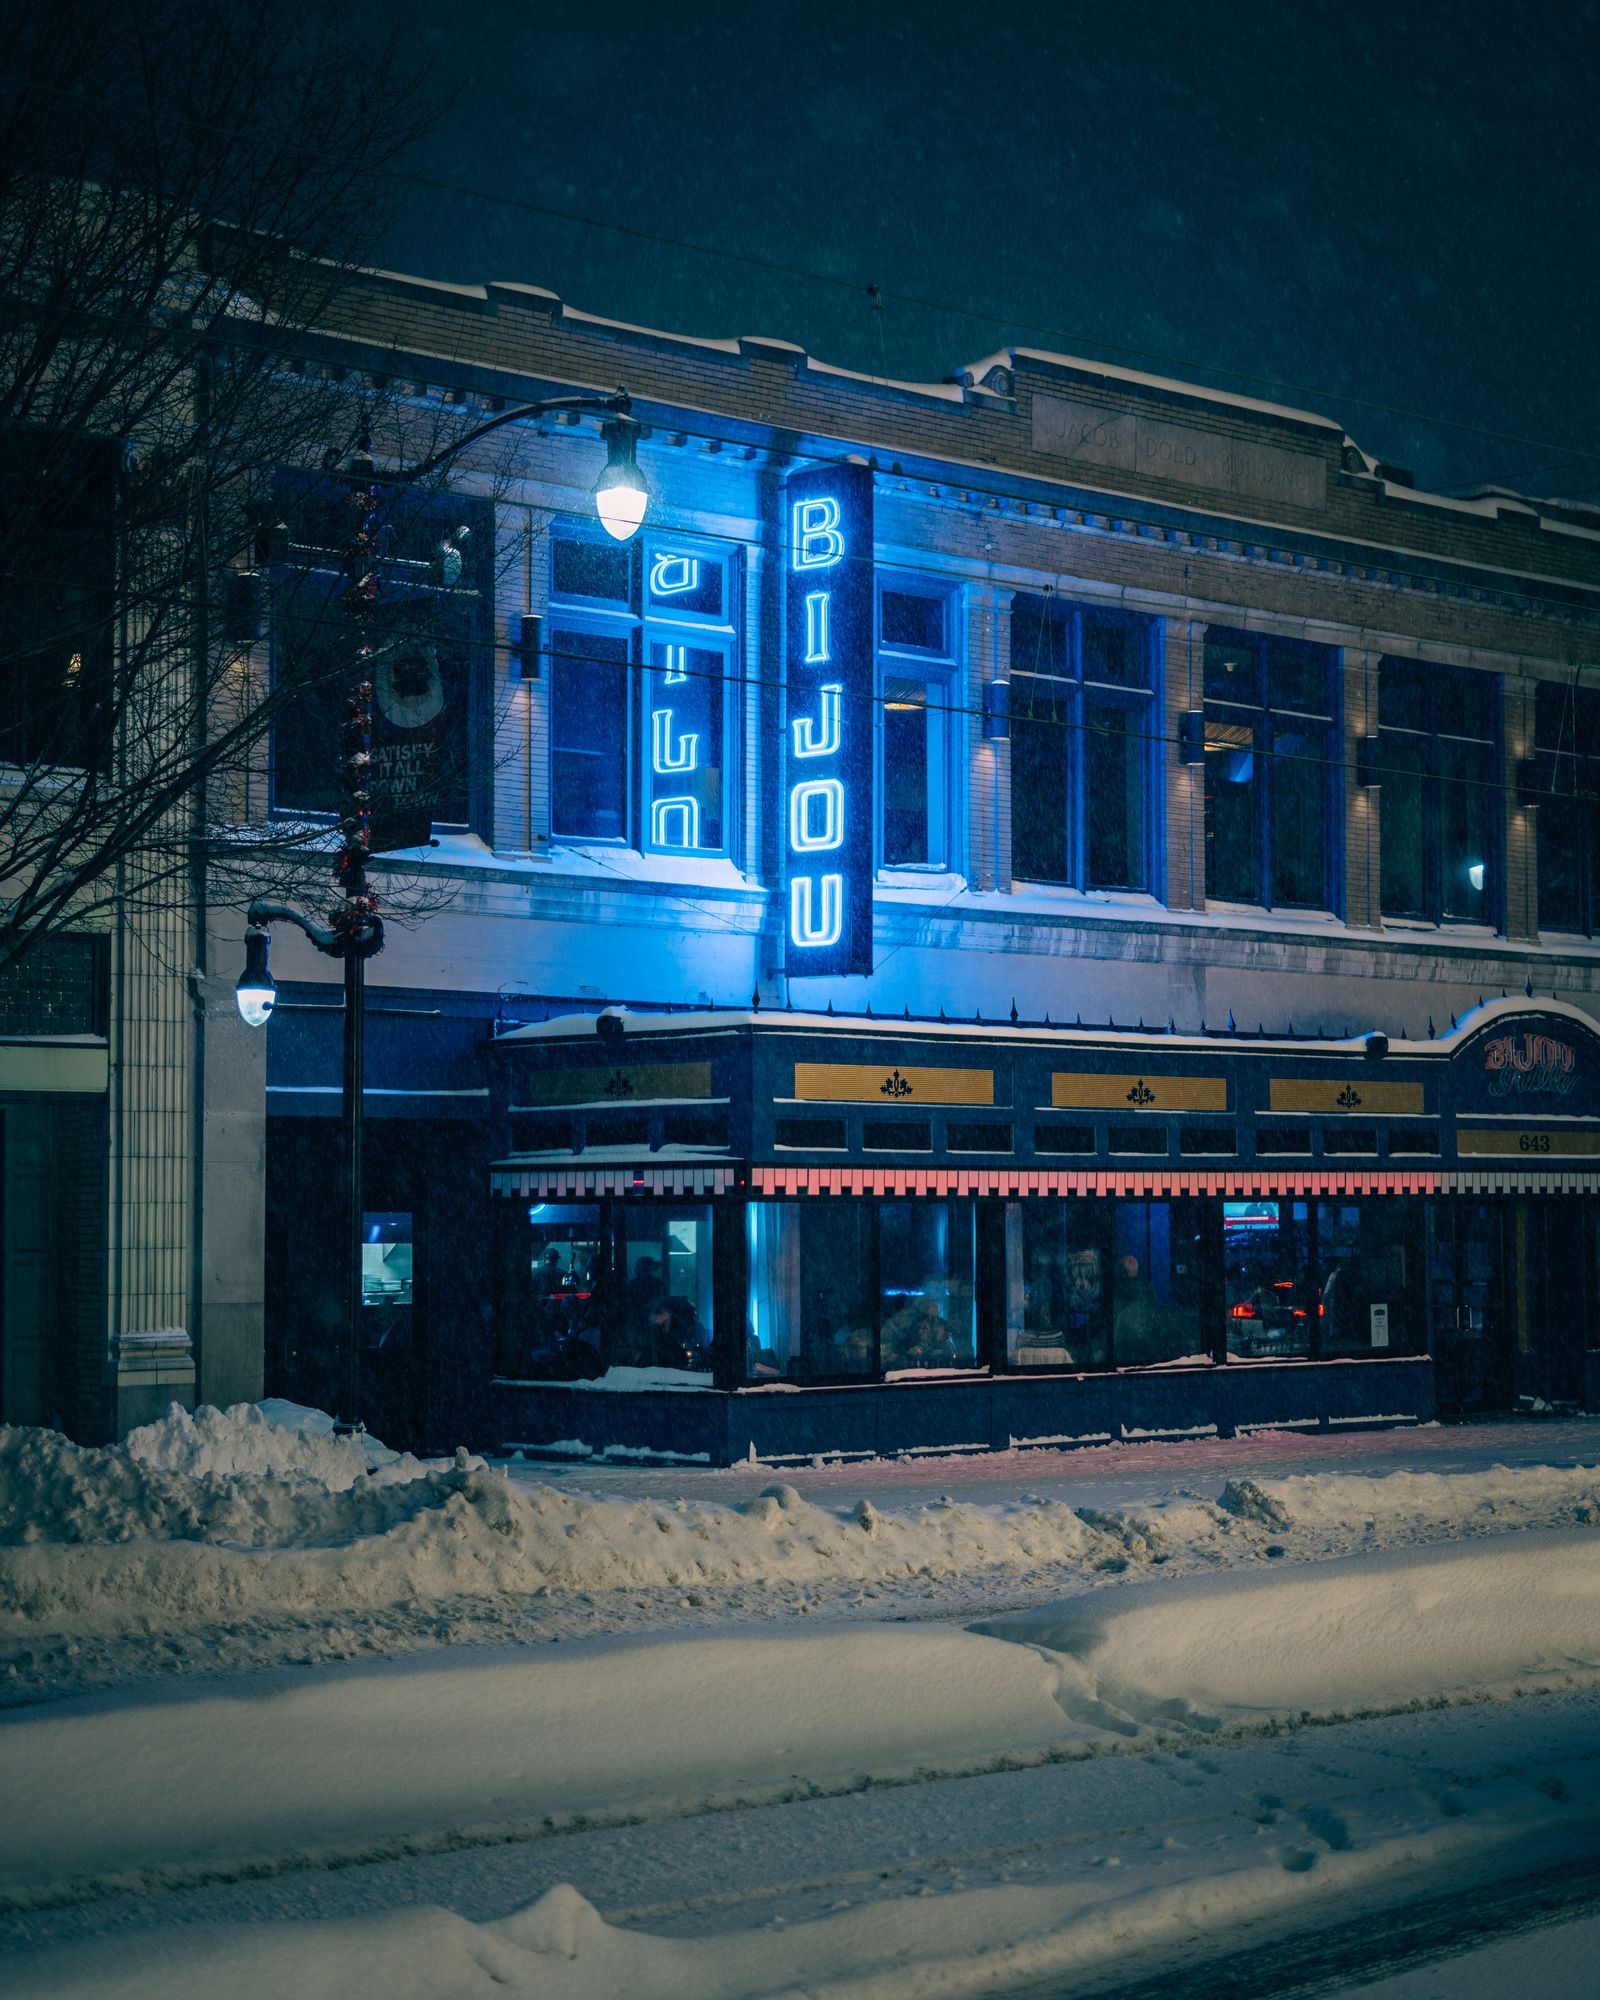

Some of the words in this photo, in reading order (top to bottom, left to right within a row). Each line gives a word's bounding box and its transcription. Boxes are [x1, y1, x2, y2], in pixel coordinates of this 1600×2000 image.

[1057, 419, 1120, 450] JACOB
[1146, 436, 1197, 467] DOLD
[791, 497, 845, 947] BIJOU
[370, 742, 435, 763] SATISFY
[379, 762, 393, 778] IT
[394, 759, 424, 777] ALL
[1484, 1033, 1576, 1073] BIJOU
[1519, 1134, 1550, 1151] 643
